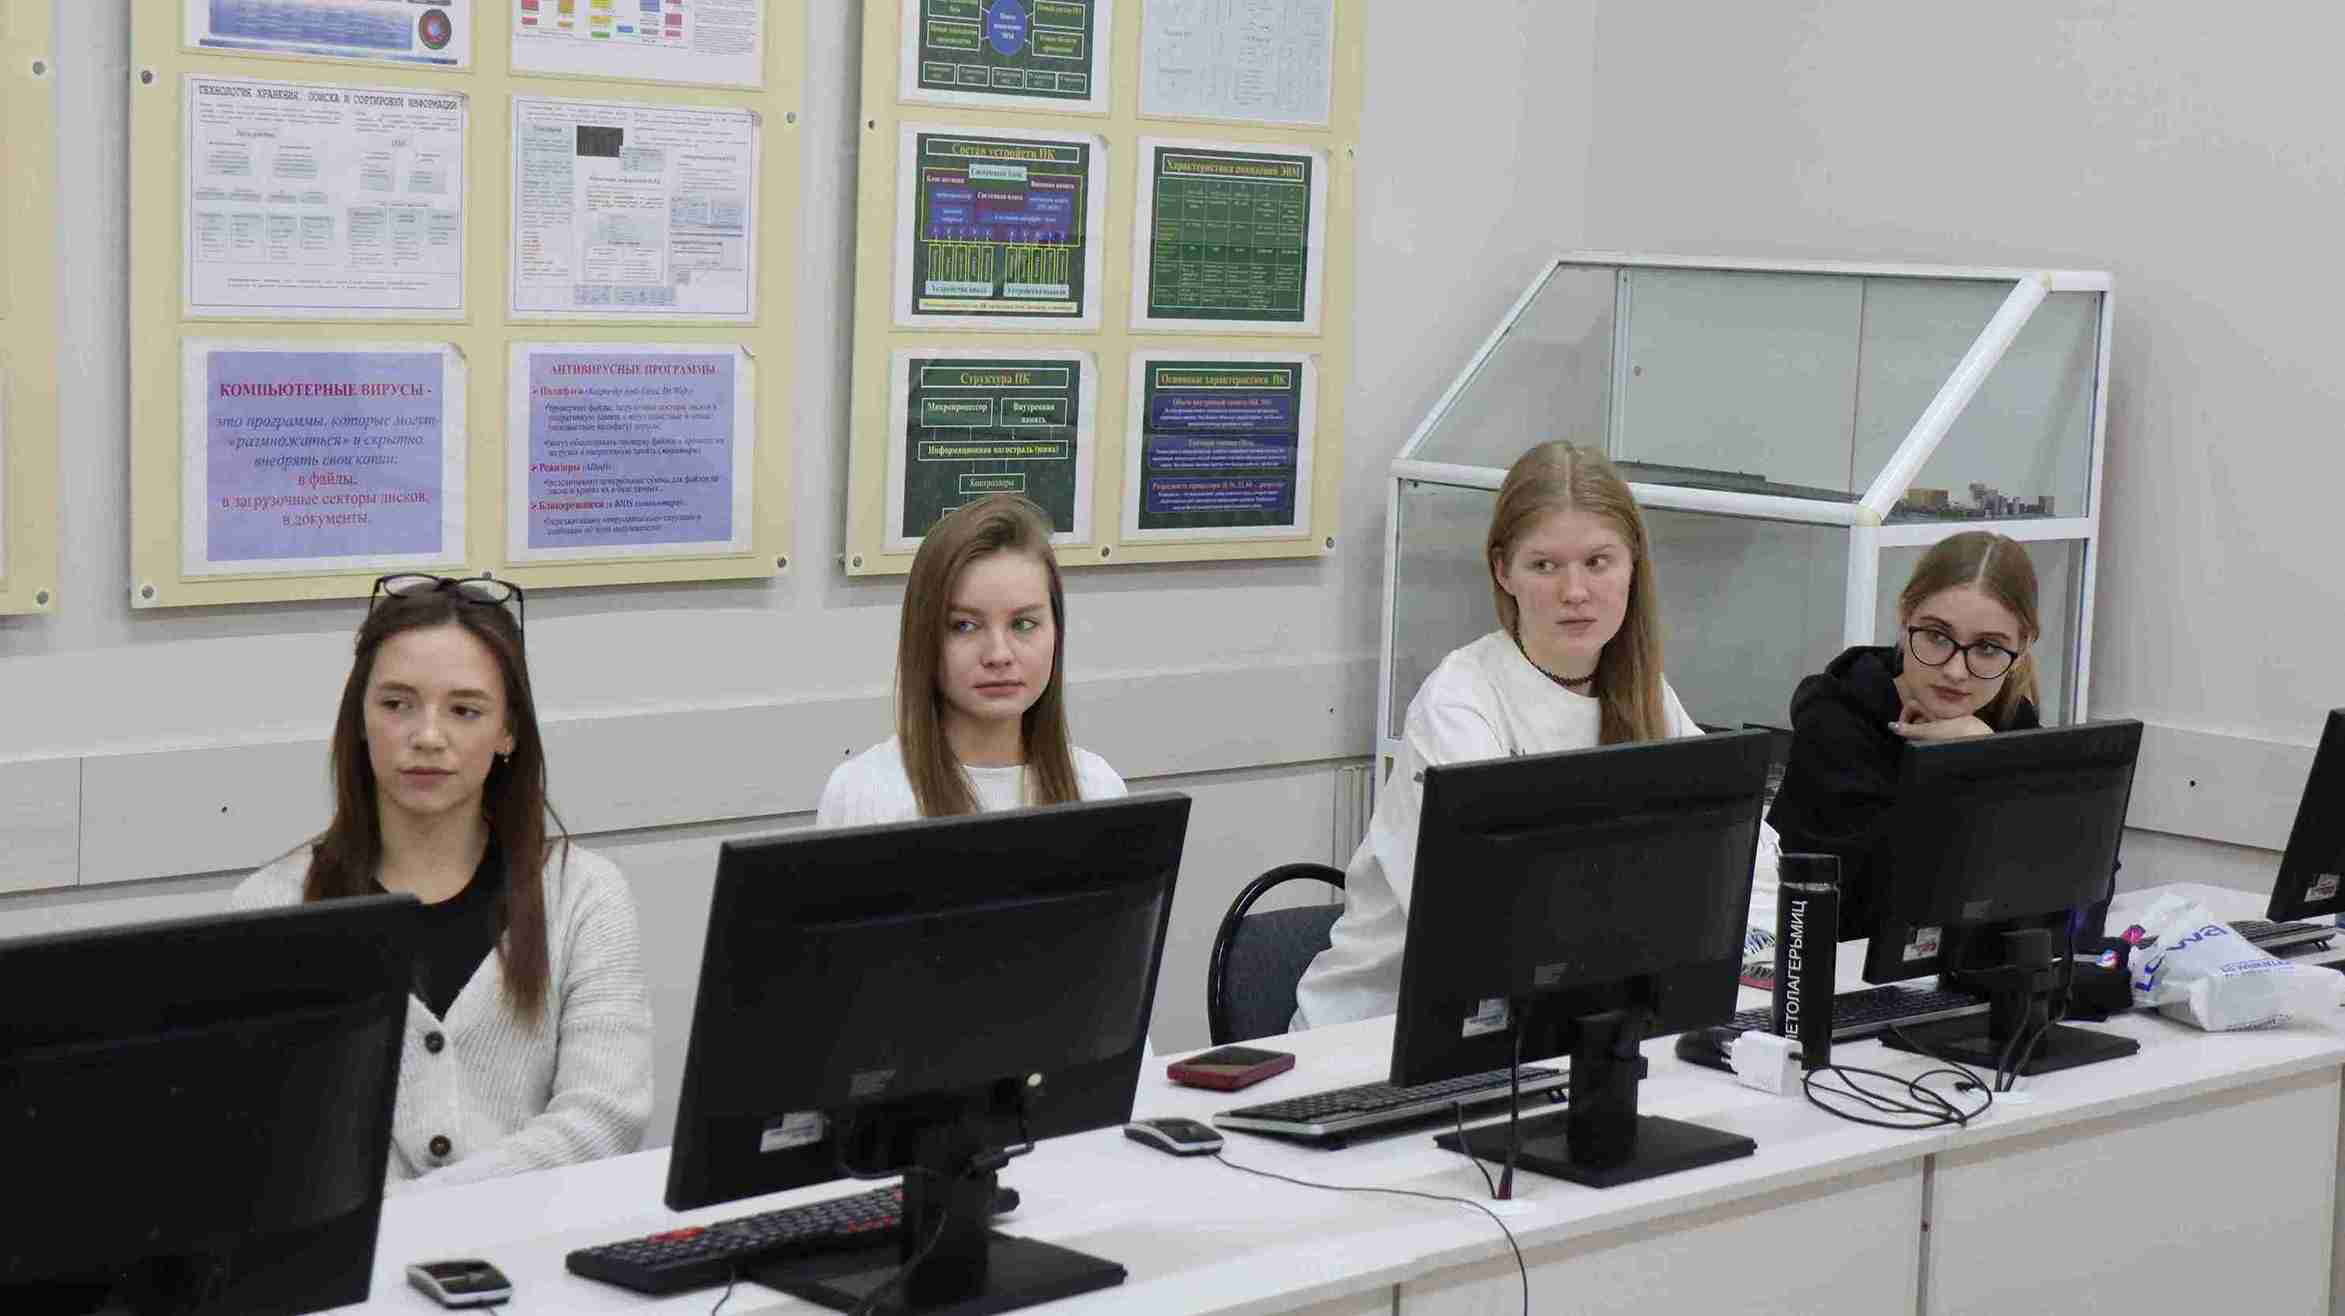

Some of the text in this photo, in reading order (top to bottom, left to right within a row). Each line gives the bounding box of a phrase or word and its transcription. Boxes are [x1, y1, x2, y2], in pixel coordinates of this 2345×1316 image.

[951, 142, 988, 155] Состав
[1040, 147, 1057, 159] ПК
[551, 363, 716, 376] АНТИВИРУСНЫЕ ПРОГРАММЫ
[959, 371, 1032, 386] Структура ПК
[219, 383, 354, 397] КОМПЬЮТЕРНЫЕ
[361, 383, 424, 397] ВИРУСЫ
[927, 401, 988, 414] Микропроцессор
[216, 417, 243, 428] это
[245, 415, 327, 430] программы,
[331, 415, 391, 429] которые
[353, 436, 362, 447] и
[364, 434, 423, 449] скрытно
[927, 444, 991, 456] Информационная
[254, 453, 319, 470] внедрять
[322, 455, 352, 466] свои
[298, 475, 305, 486] в
[222, 497, 229, 508] в
[234, 495, 319, 513] загрузочные
[321, 493, 377, 508] секторы
